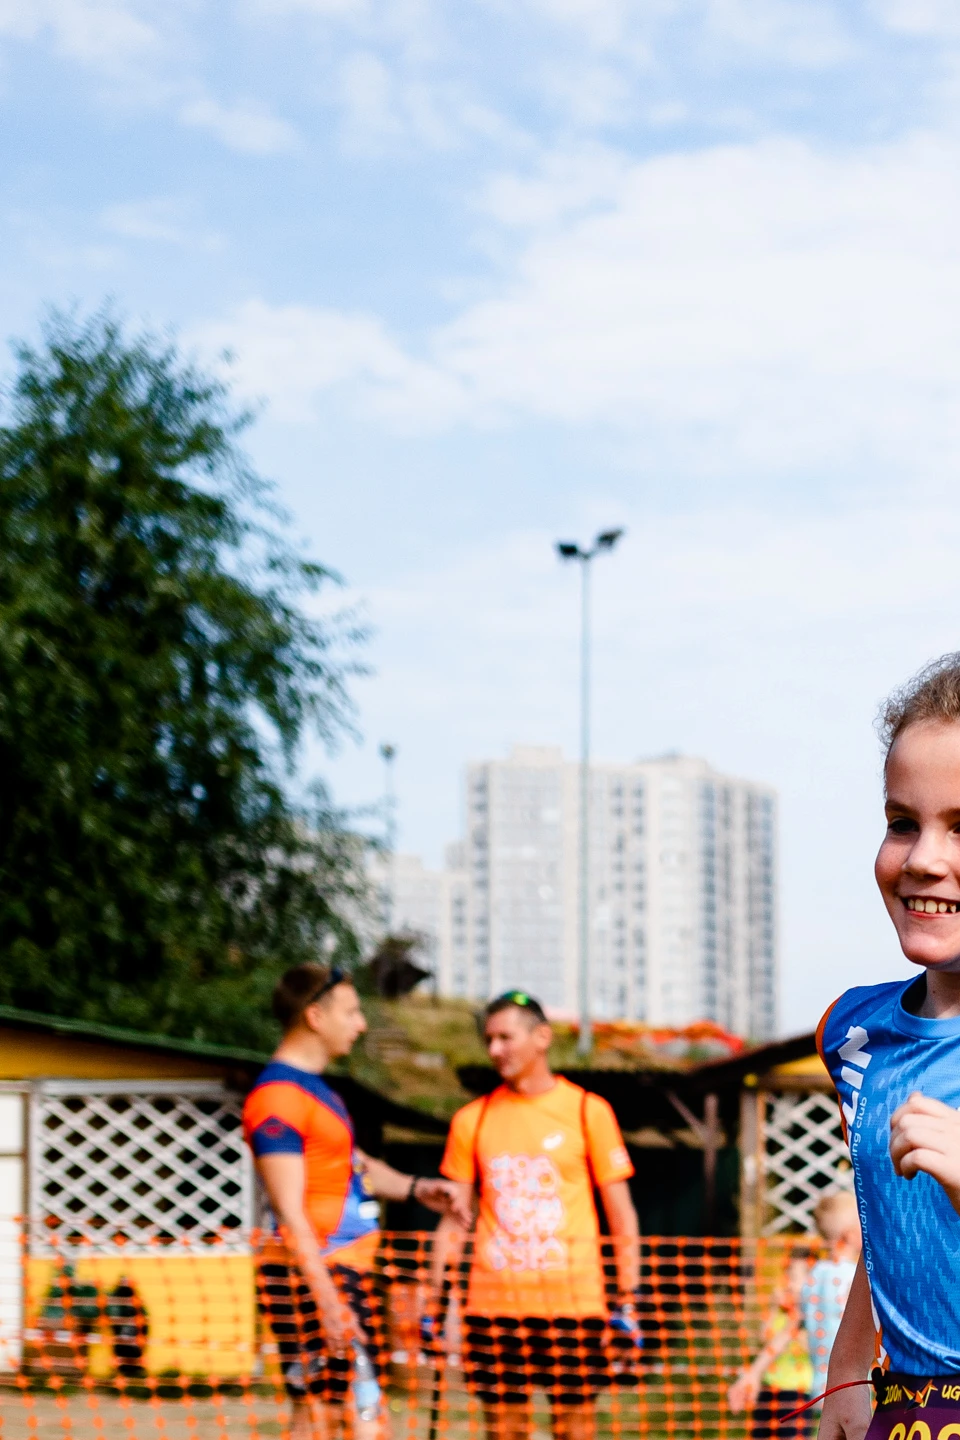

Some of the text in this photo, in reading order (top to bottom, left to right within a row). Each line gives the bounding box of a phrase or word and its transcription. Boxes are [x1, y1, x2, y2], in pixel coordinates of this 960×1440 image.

[837, 1025, 872, 1132] LIN
[856, 1096, 868, 1129] club
[850, 1132, 865, 1193] running
